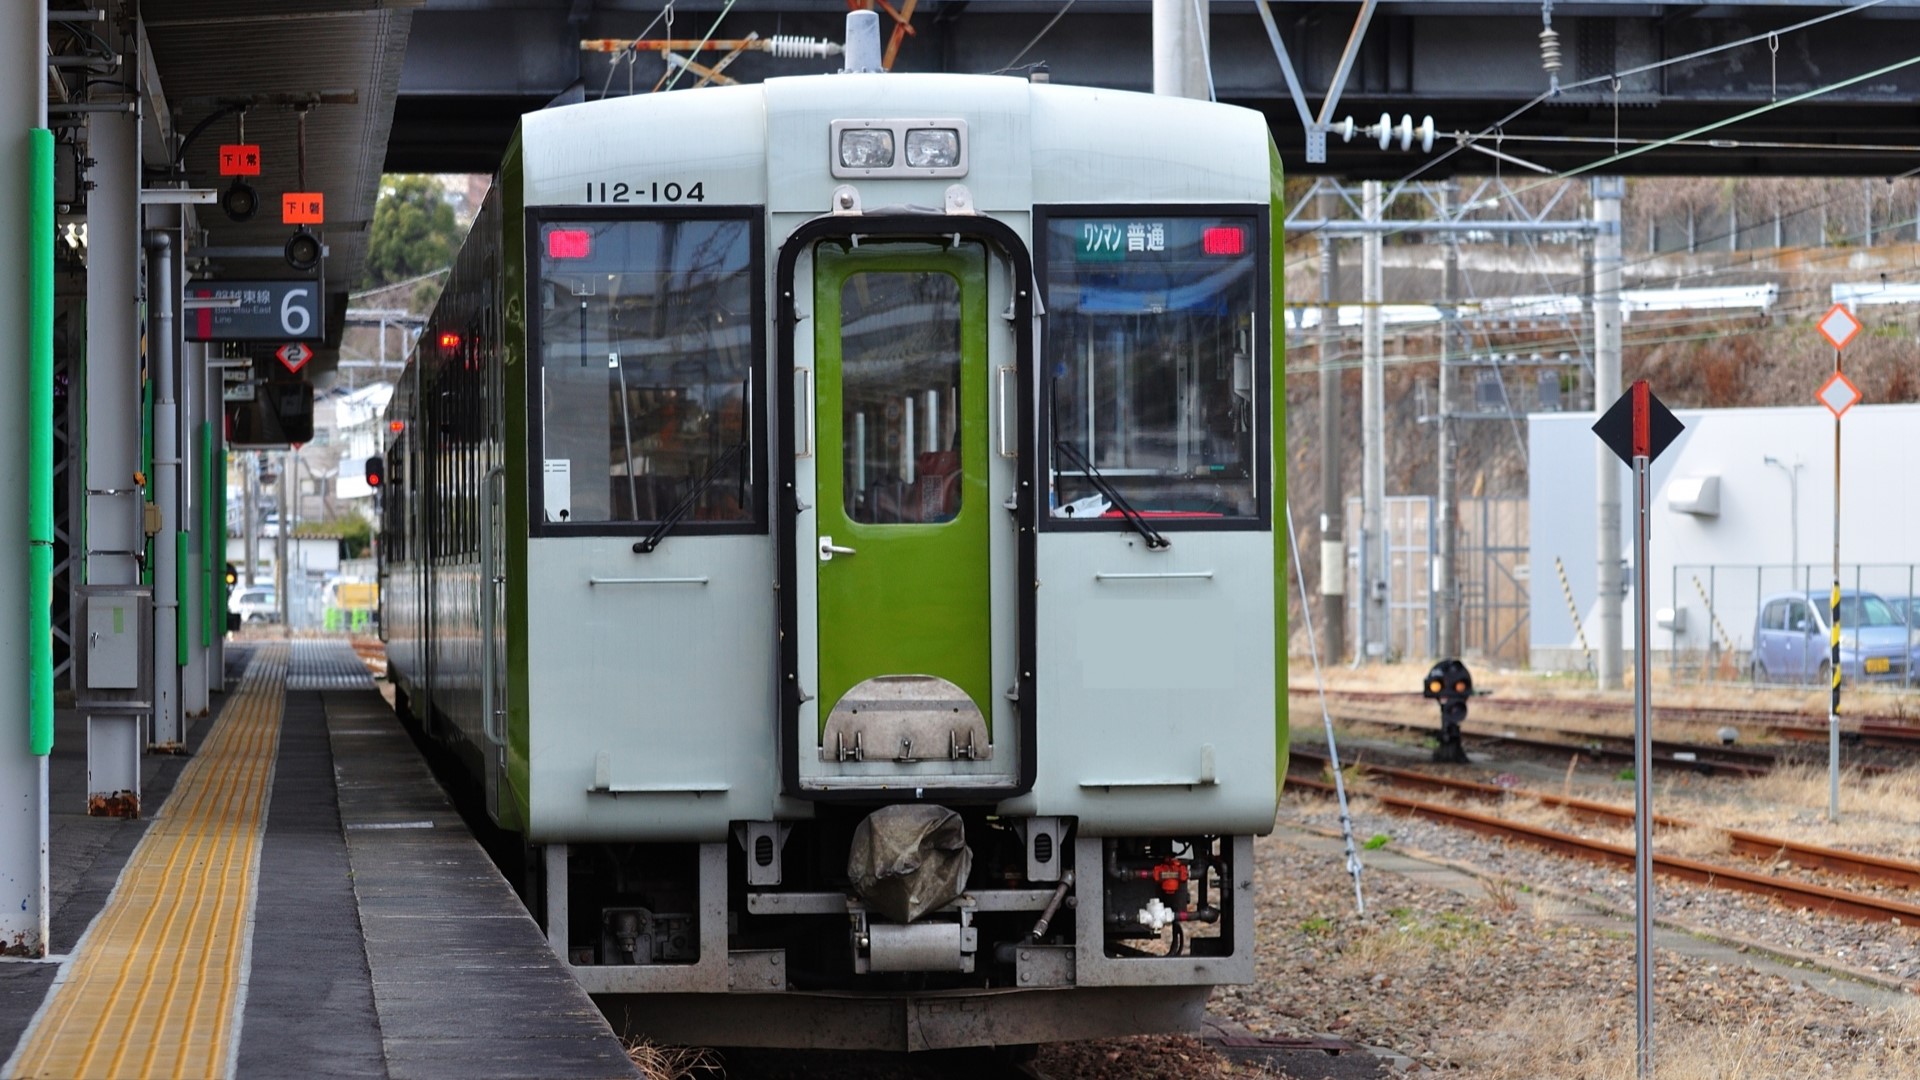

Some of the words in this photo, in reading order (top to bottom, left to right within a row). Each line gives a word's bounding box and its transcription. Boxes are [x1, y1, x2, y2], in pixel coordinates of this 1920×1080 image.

[587, 182, 704, 202] 112-104
[1084, 223, 1121, 252] ワンマン
[1127, 222, 1165, 252] 普通
[280, 288, 311, 335] 6
